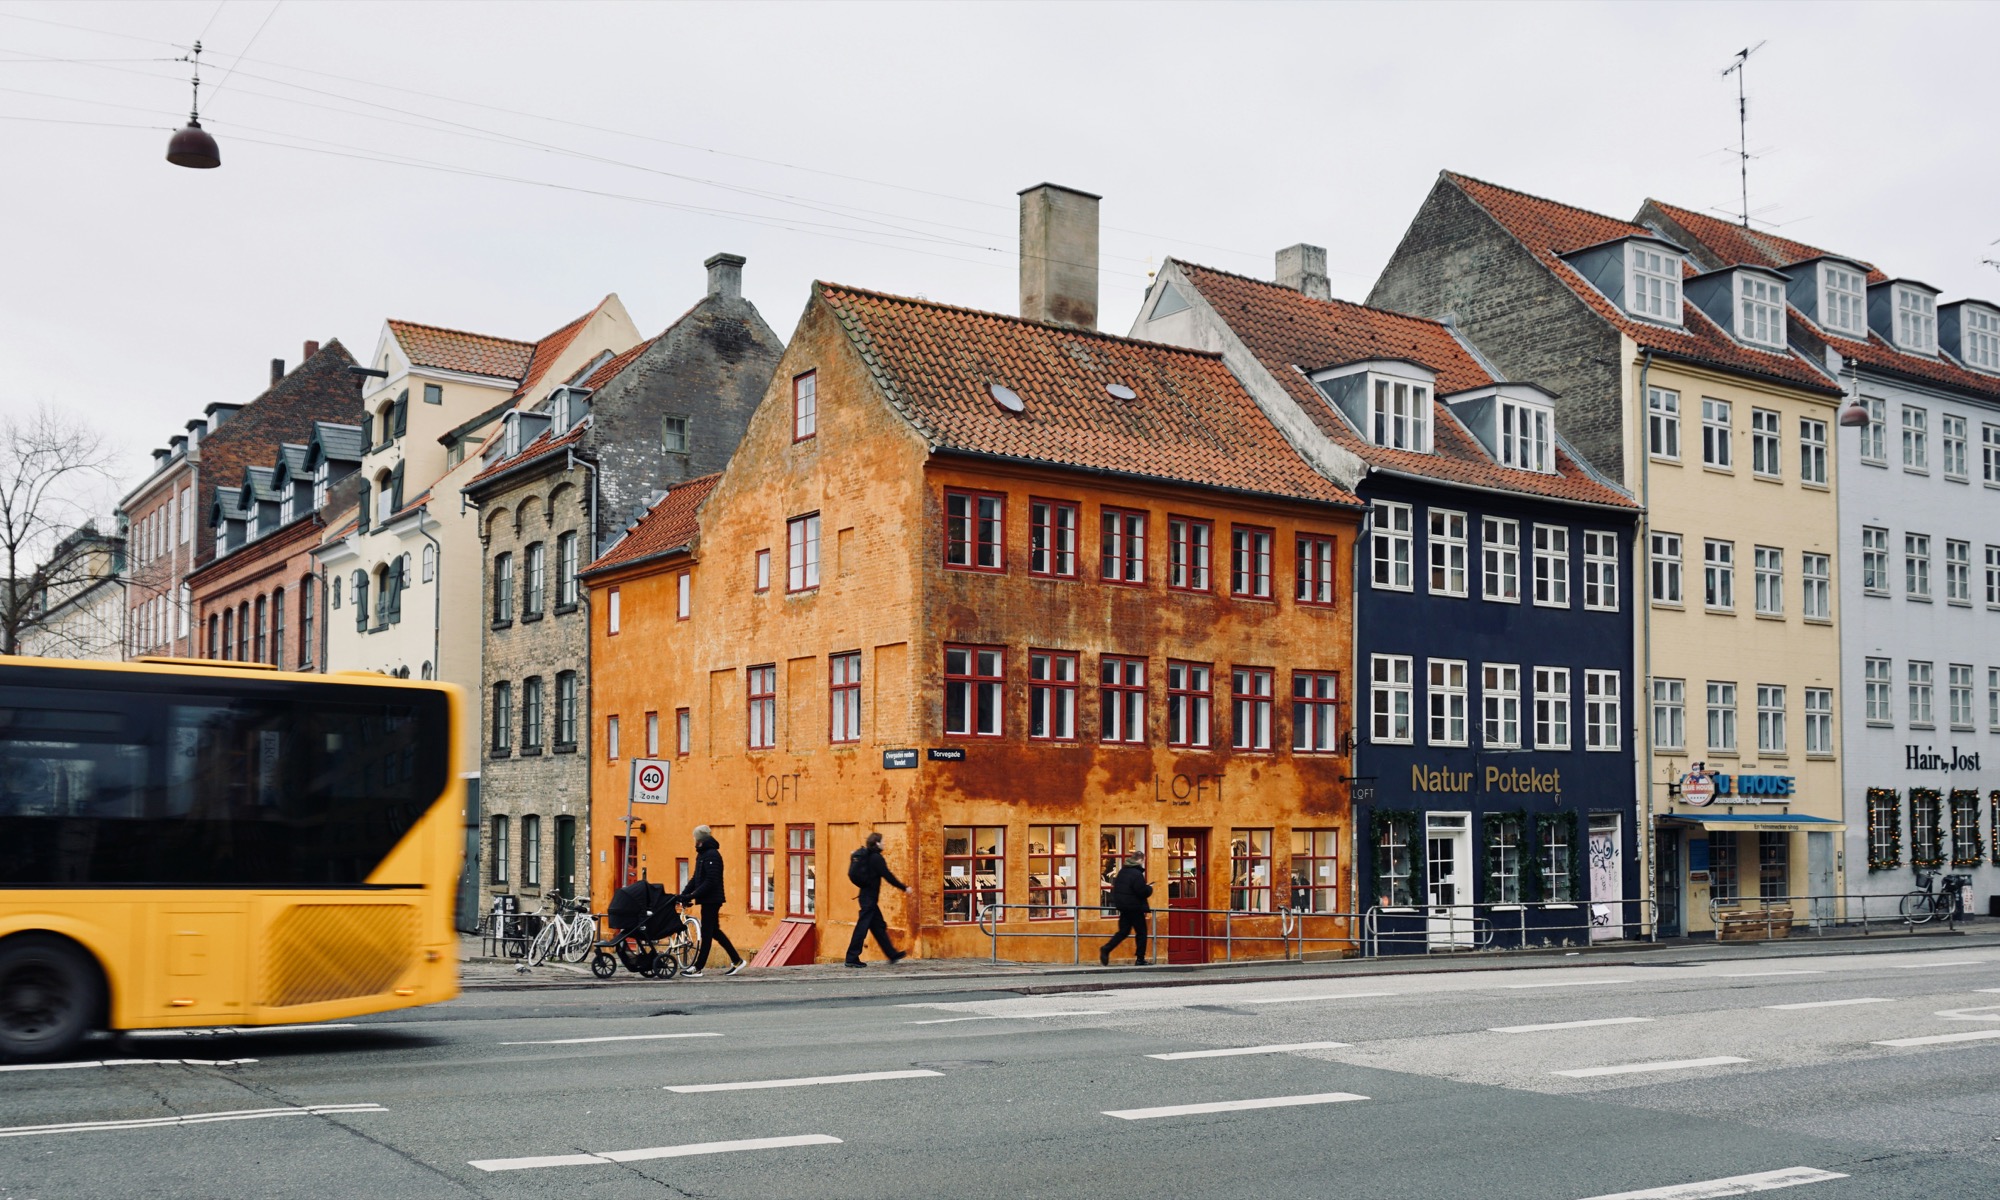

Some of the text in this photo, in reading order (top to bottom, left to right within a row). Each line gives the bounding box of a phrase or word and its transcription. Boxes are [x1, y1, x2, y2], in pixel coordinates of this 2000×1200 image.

[933, 750, 961, 758] Torvegade
[1905, 745, 1982, 774] Hair by Jost
[643, 773, 660, 784] 40
[1155, 773, 1226, 802] LOFT
[1412, 764, 1562, 793] Natur Poteket
[1743, 775, 1796, 794] HOUSE
[641, 793, 660, 801] Zone
[756, 774, 801, 803] LOFT
[1352, 788, 1374, 799] LOFT
